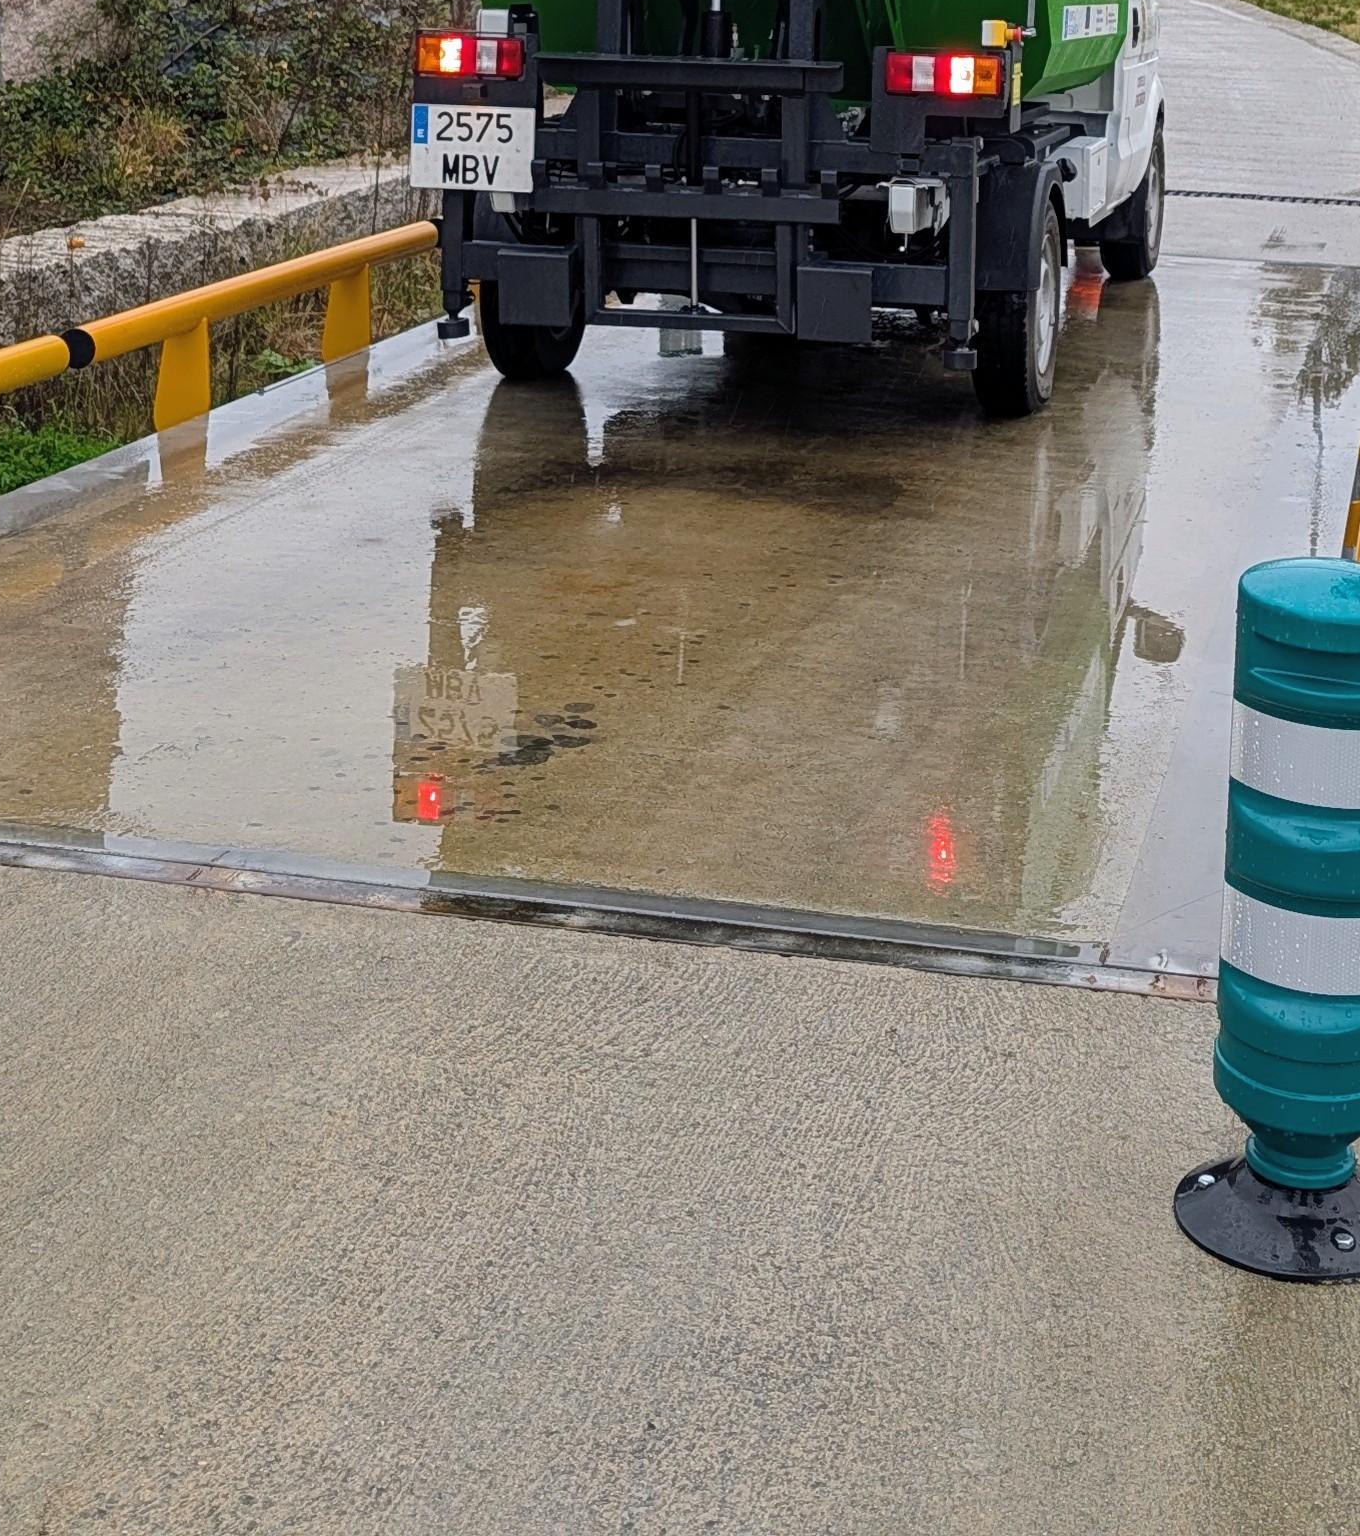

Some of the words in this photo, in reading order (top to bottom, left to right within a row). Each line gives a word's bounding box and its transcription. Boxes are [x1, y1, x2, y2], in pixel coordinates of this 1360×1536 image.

[417, 129, 425, 138] E
[435, 111, 513, 144] 2575
[441, 152, 500, 186] MBV
